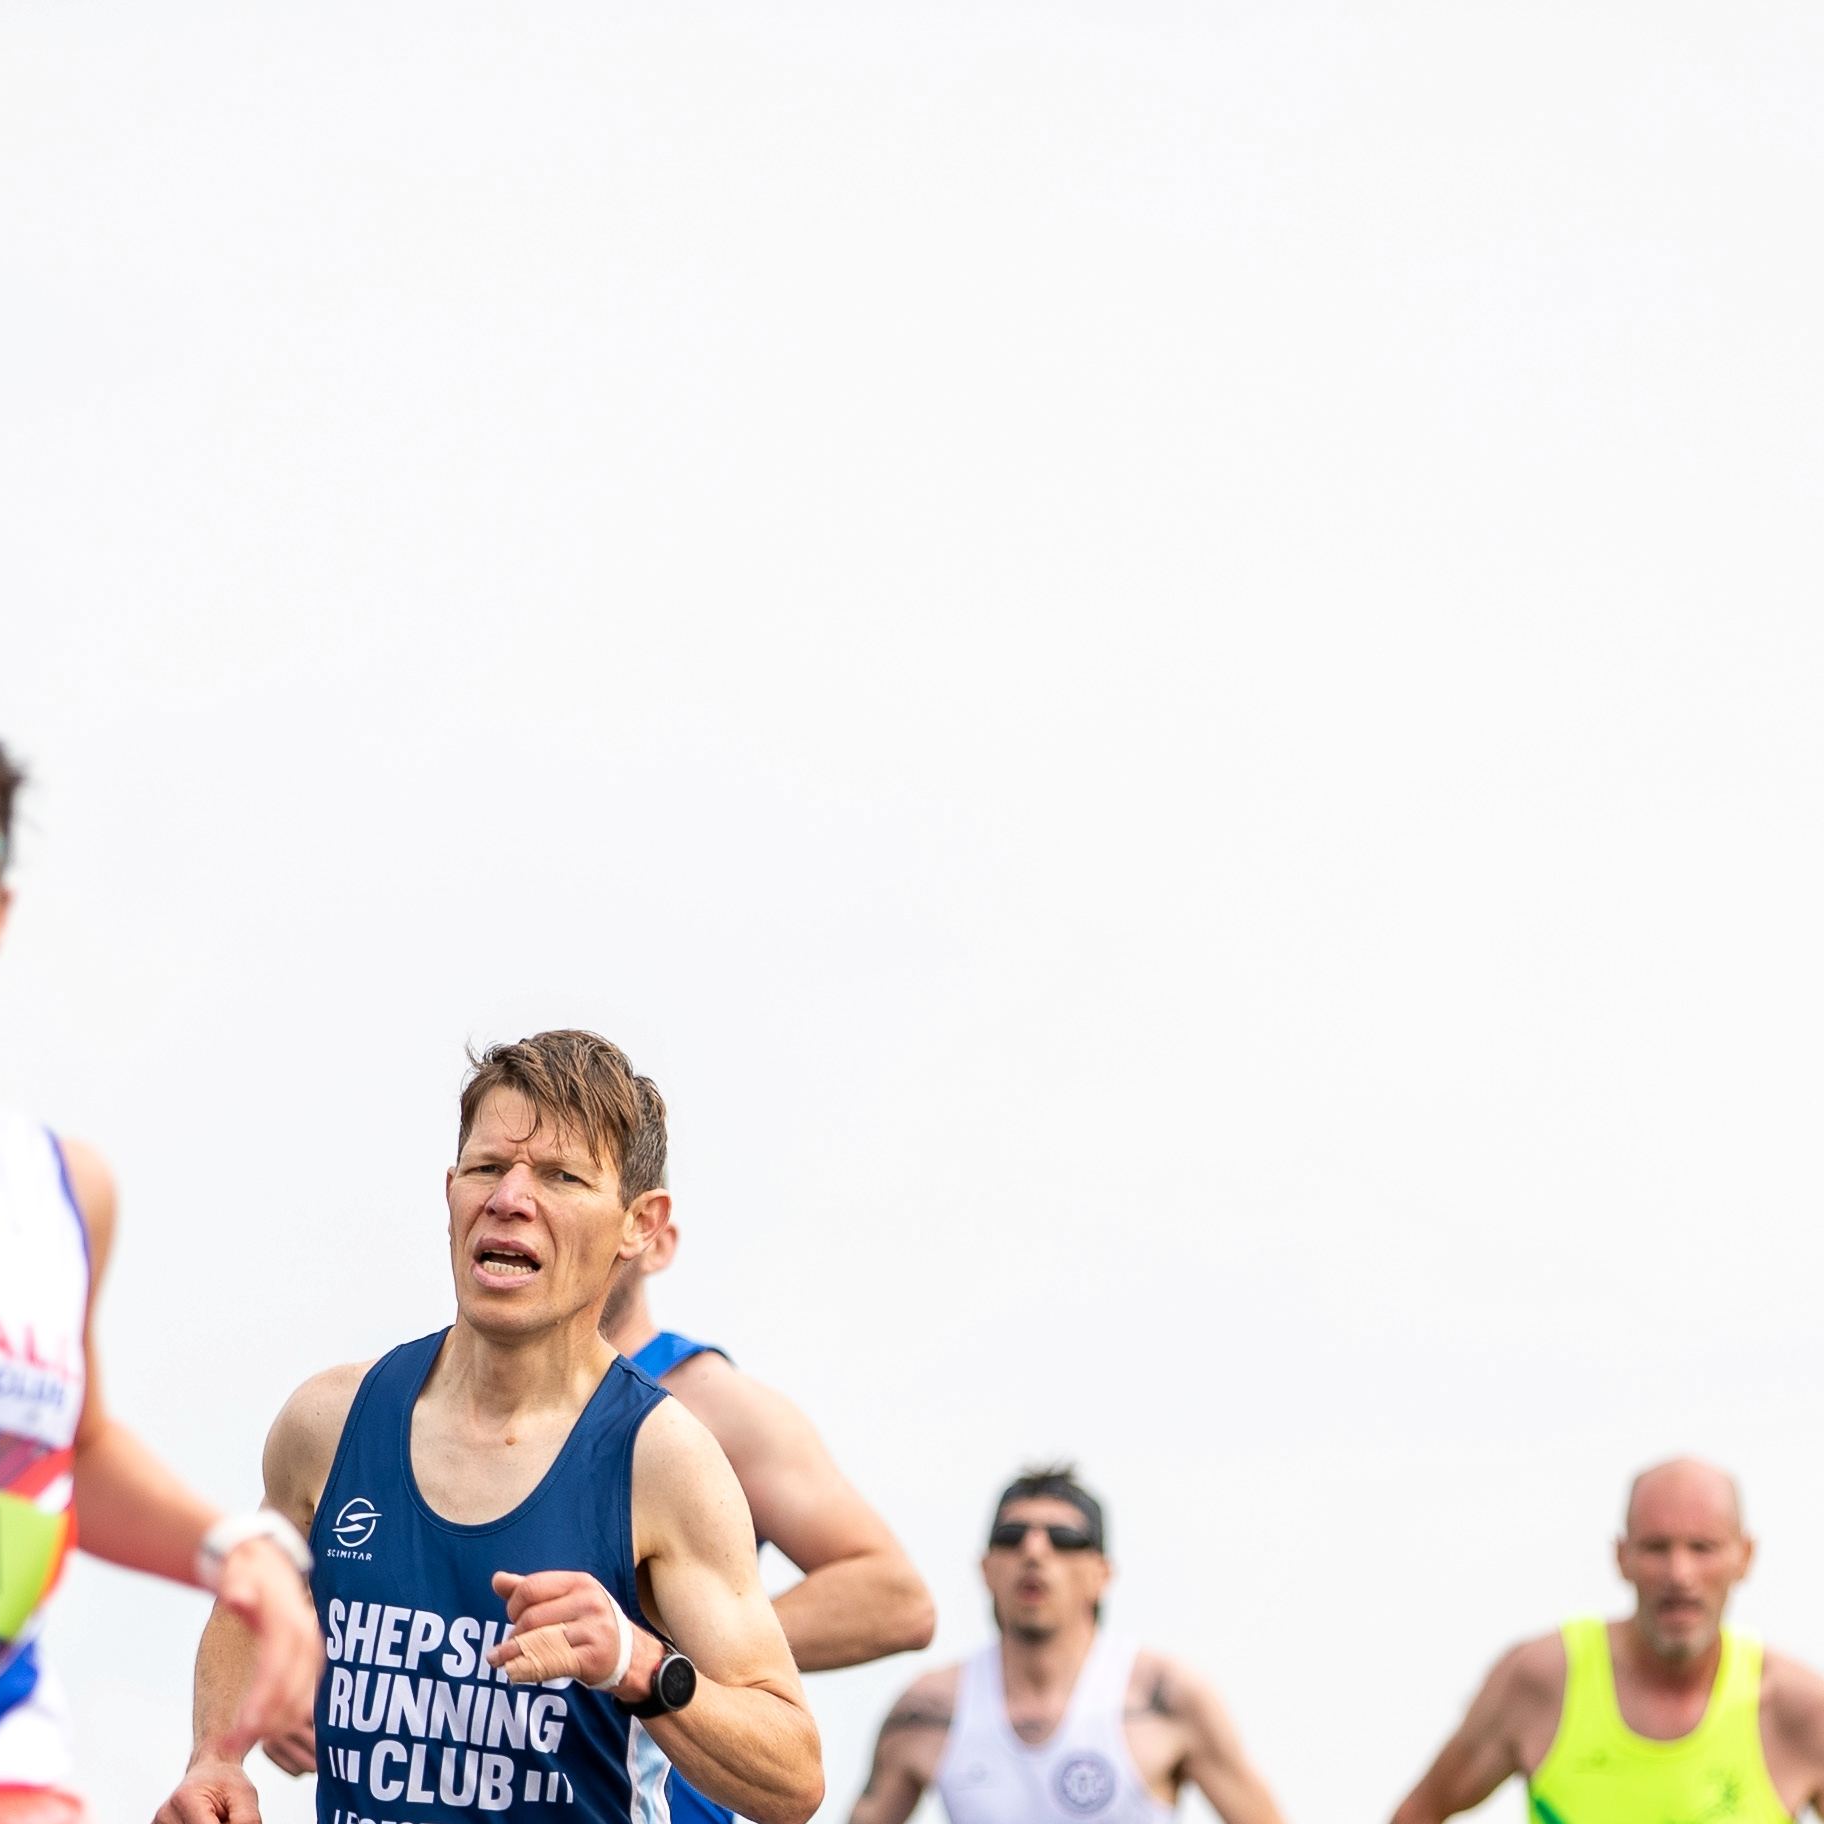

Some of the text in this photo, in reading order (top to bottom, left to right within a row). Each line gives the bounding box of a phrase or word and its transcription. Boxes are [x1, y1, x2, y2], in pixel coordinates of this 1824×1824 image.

[327, 1548, 373, 1561] SCIMITAR
[328, 1666, 568, 1754] RUNNING
[369, 1739, 515, 1811] CLUB
